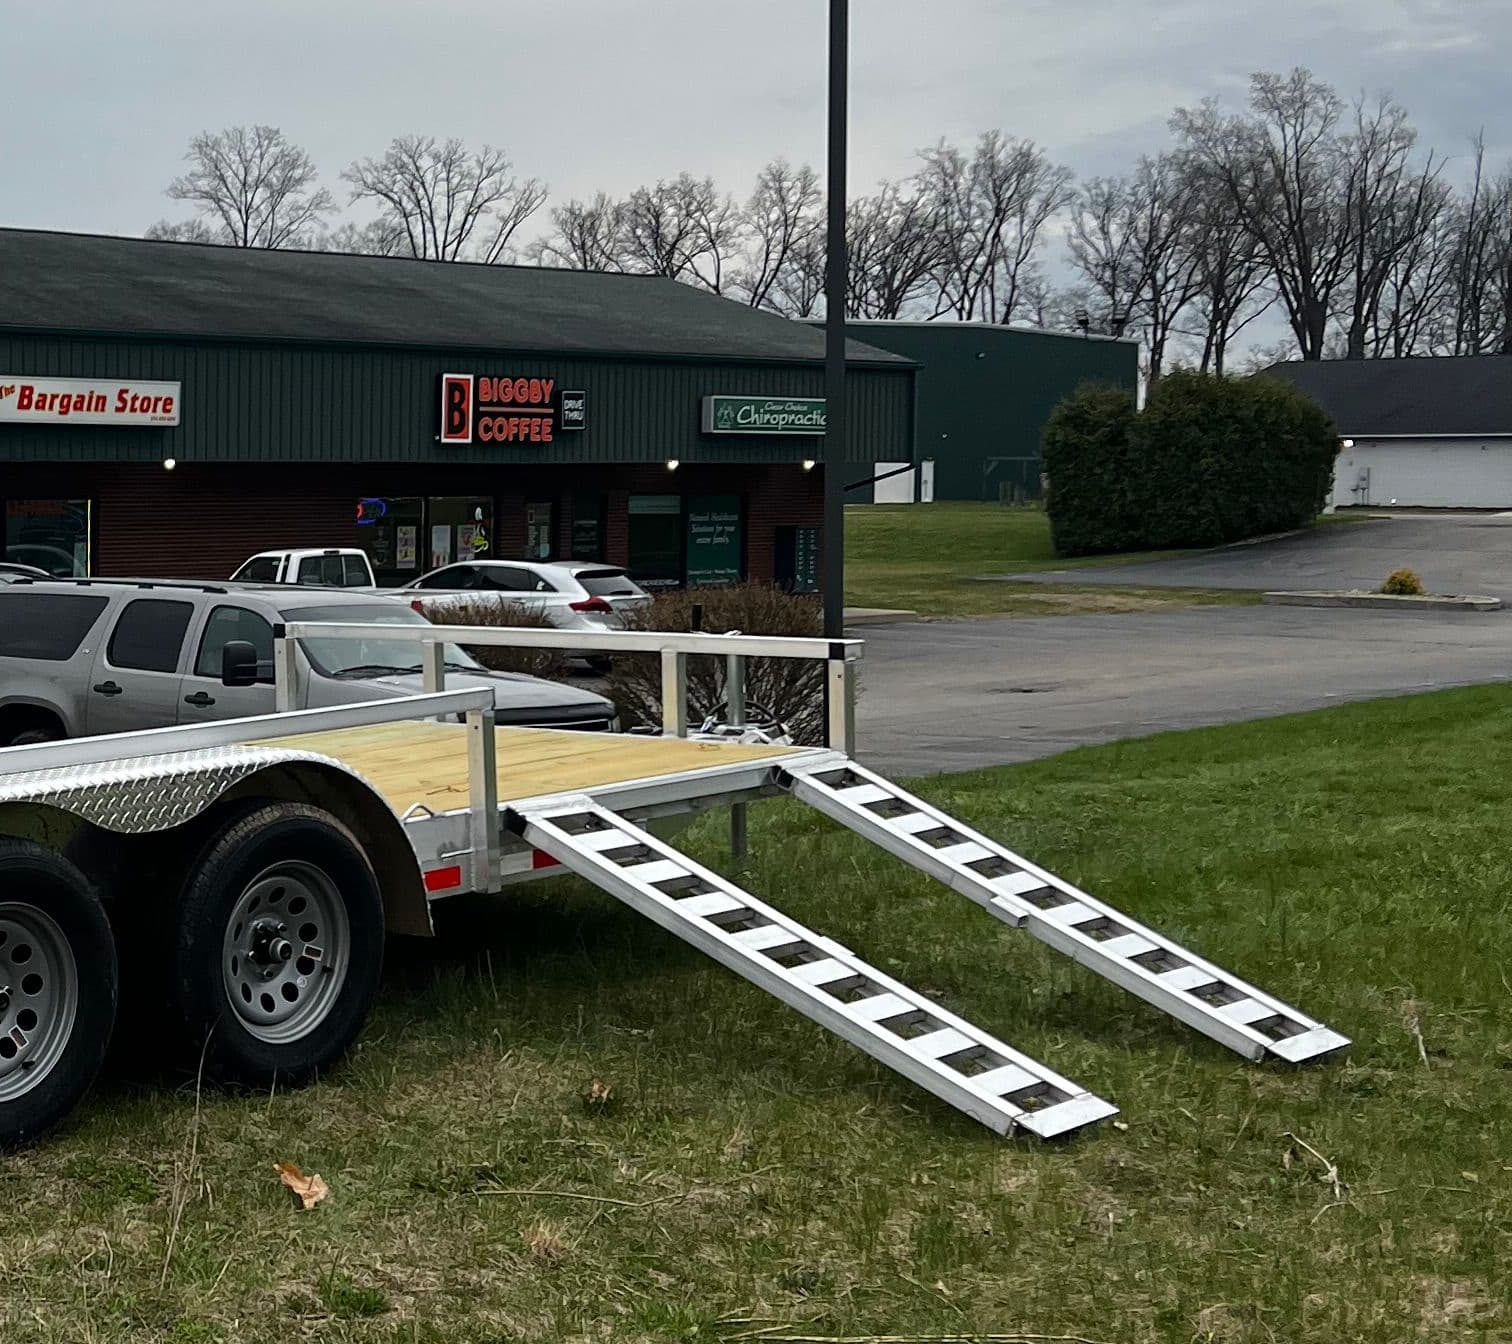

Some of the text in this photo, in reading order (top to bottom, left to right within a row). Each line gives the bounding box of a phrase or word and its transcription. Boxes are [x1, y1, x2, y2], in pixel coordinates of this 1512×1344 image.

[17, 385, 107, 416] Bargain
[115, 389, 174, 414] Store
[479, 377, 554, 403] BIGGBY
[479, 416, 553, 442] COFFEE
[737, 405, 826, 430] Chiropractic
